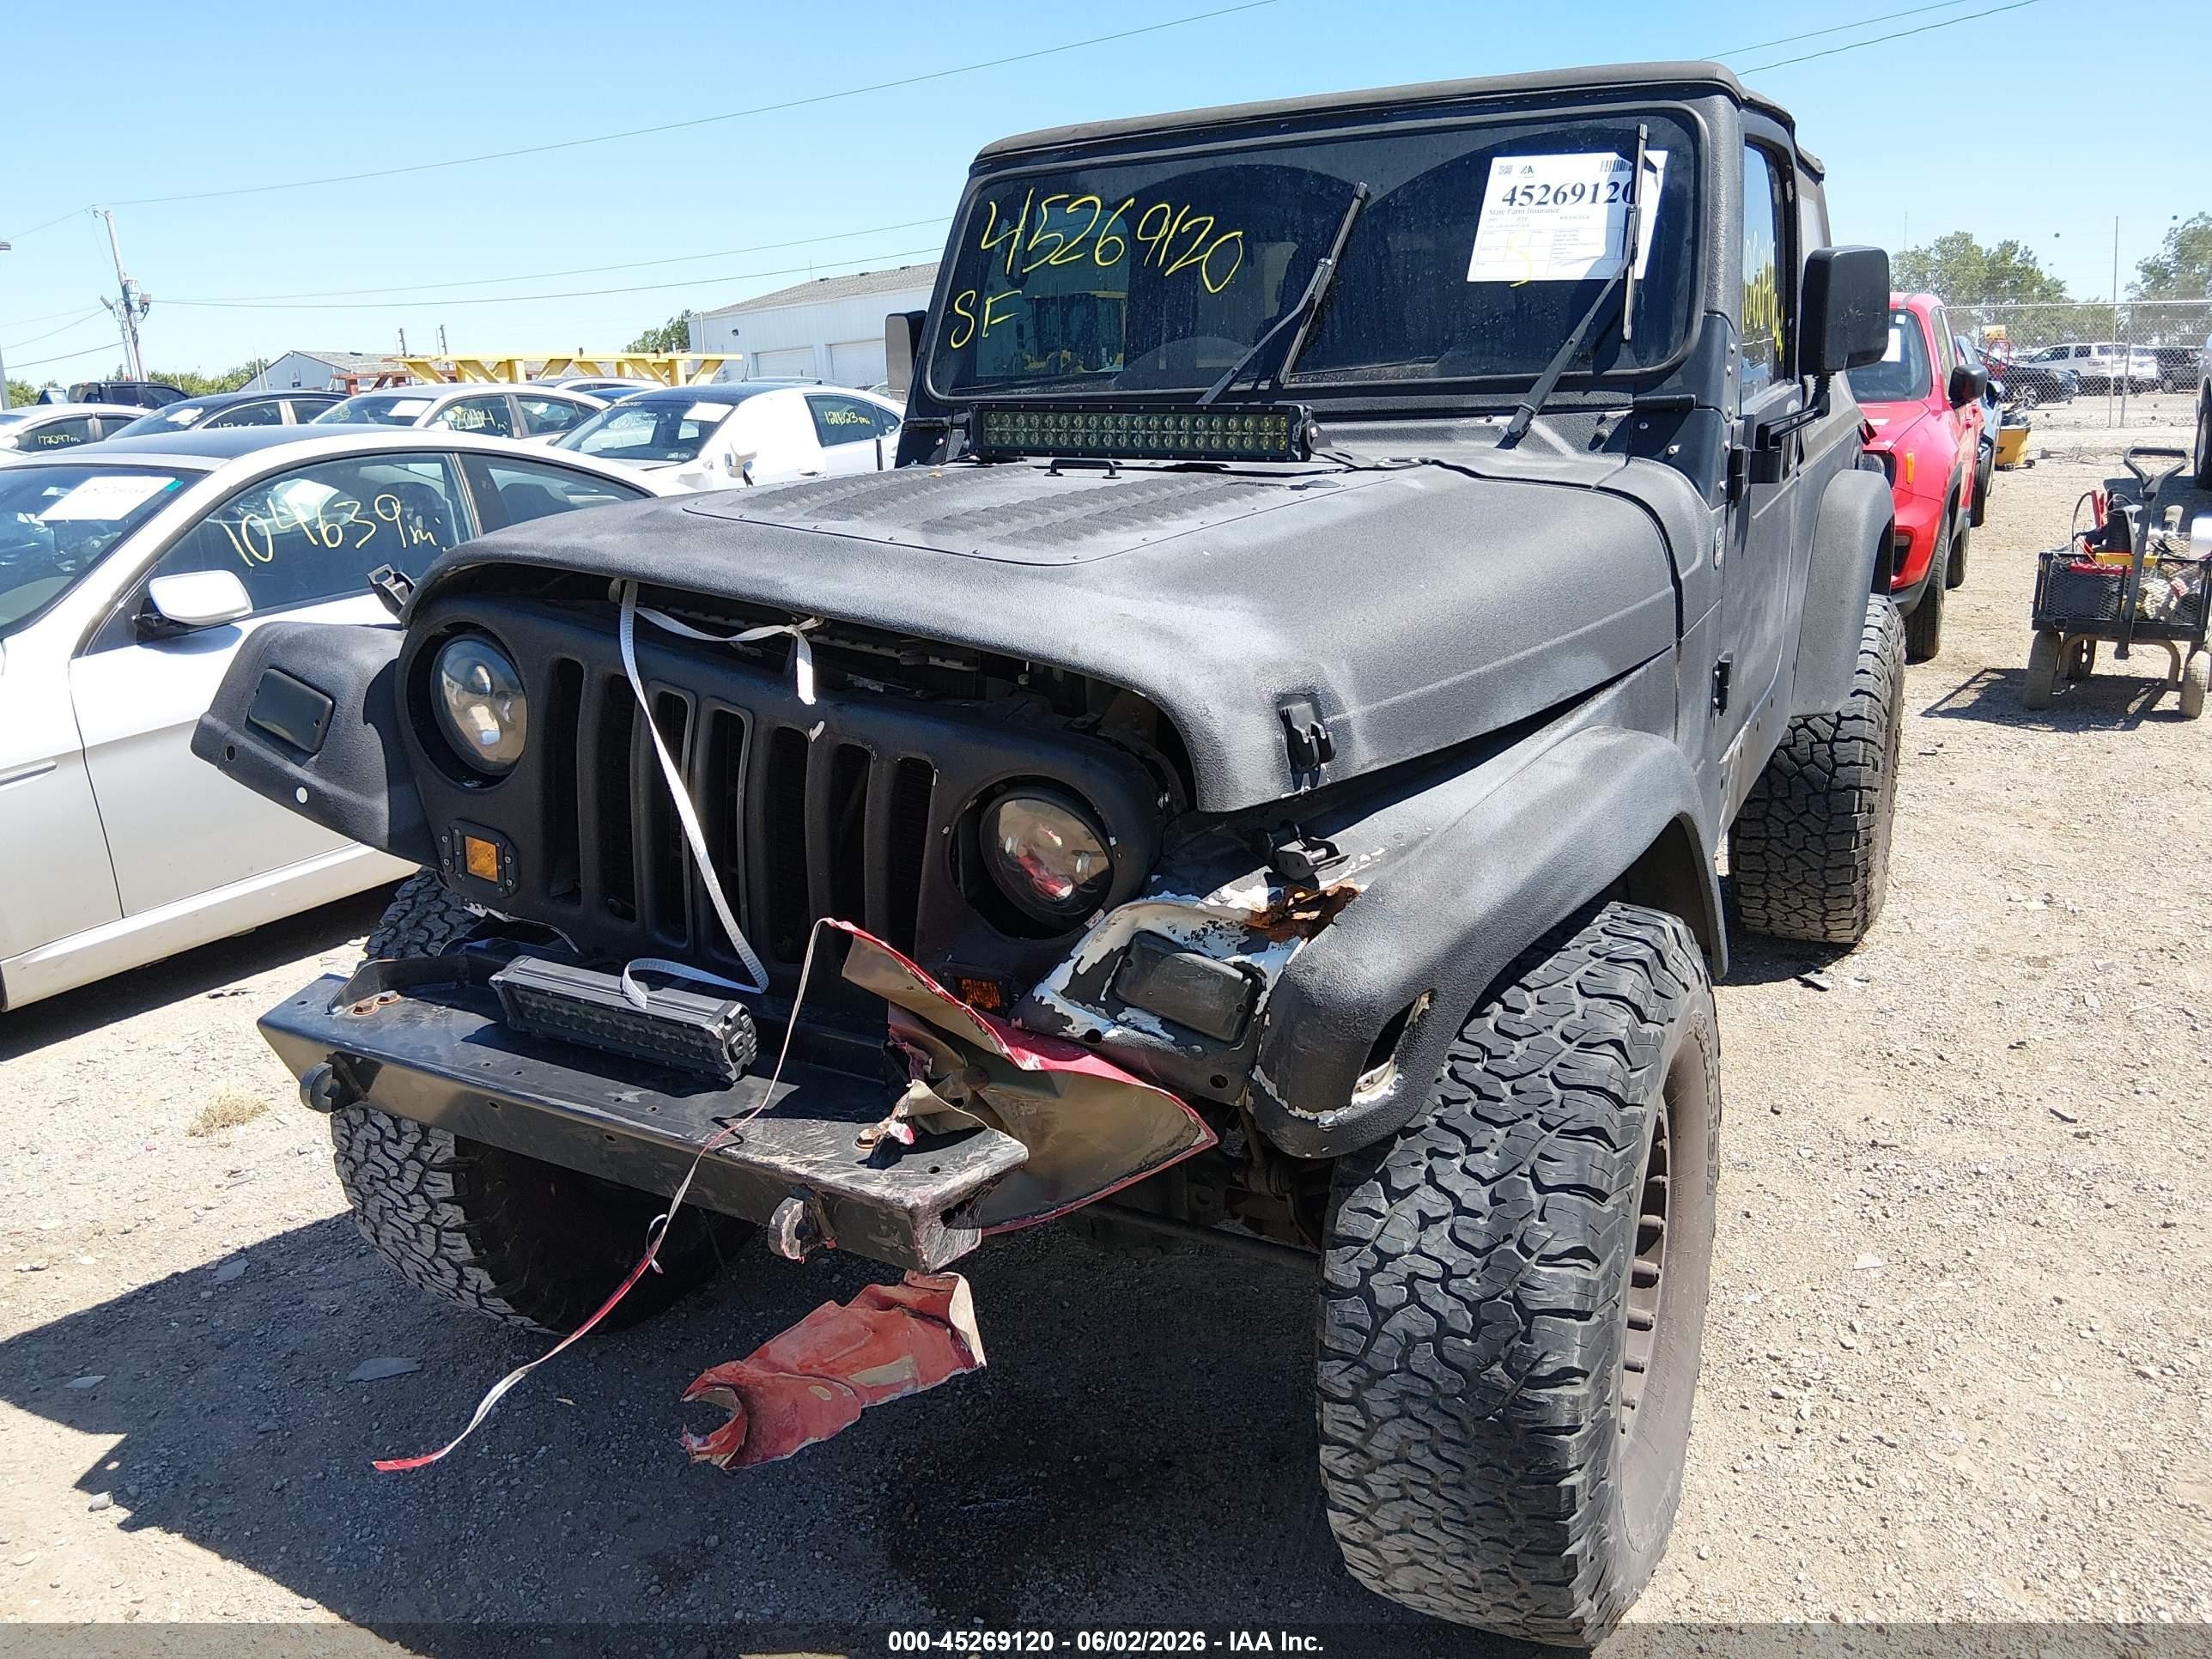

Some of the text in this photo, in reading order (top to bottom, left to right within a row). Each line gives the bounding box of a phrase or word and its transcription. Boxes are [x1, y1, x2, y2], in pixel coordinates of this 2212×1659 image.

[1501, 181, 1636, 207] 45269120
[981, 187, 1243, 294] 45269120
[951, 290, 1024, 349] SF
[219, 494, 408, 568] 104639
